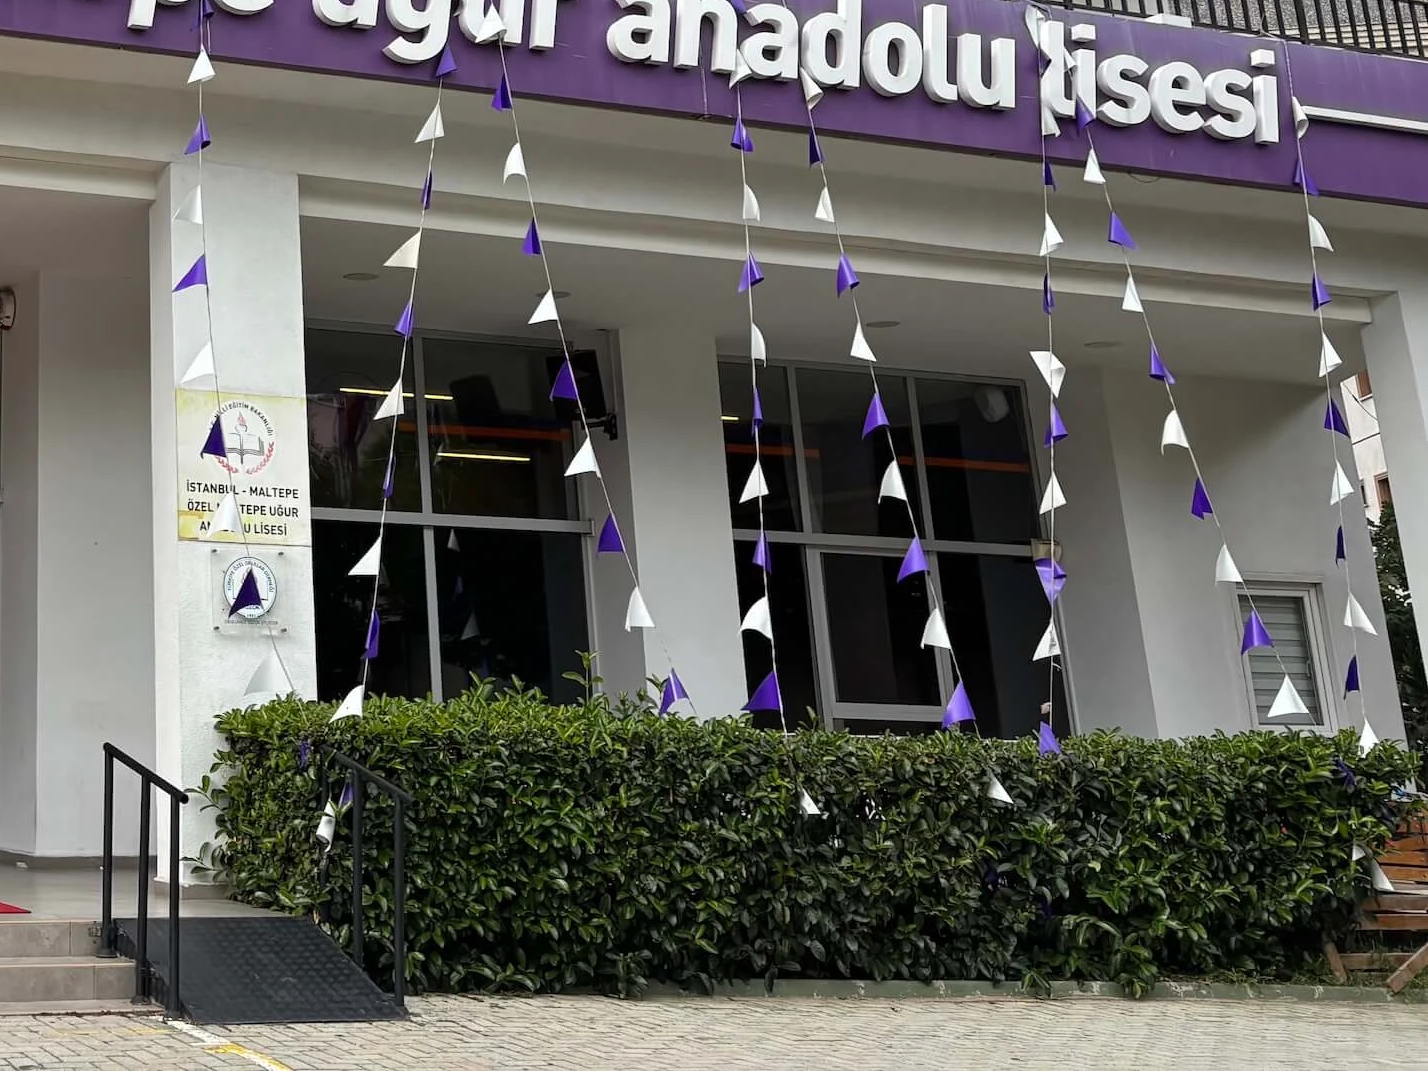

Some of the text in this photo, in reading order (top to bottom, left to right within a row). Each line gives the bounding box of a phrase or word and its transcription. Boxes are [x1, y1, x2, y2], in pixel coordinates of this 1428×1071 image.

[1039, 20, 1279, 144] lisesi
[186, 479, 239, 495] İSTANBUL
[249, 486, 300, 499] MALTEPE
[187, 498, 214, 512] ÖZEL
[269, 505, 300, 518] UĞUR
[254, 521, 288, 536] LİSESİ
